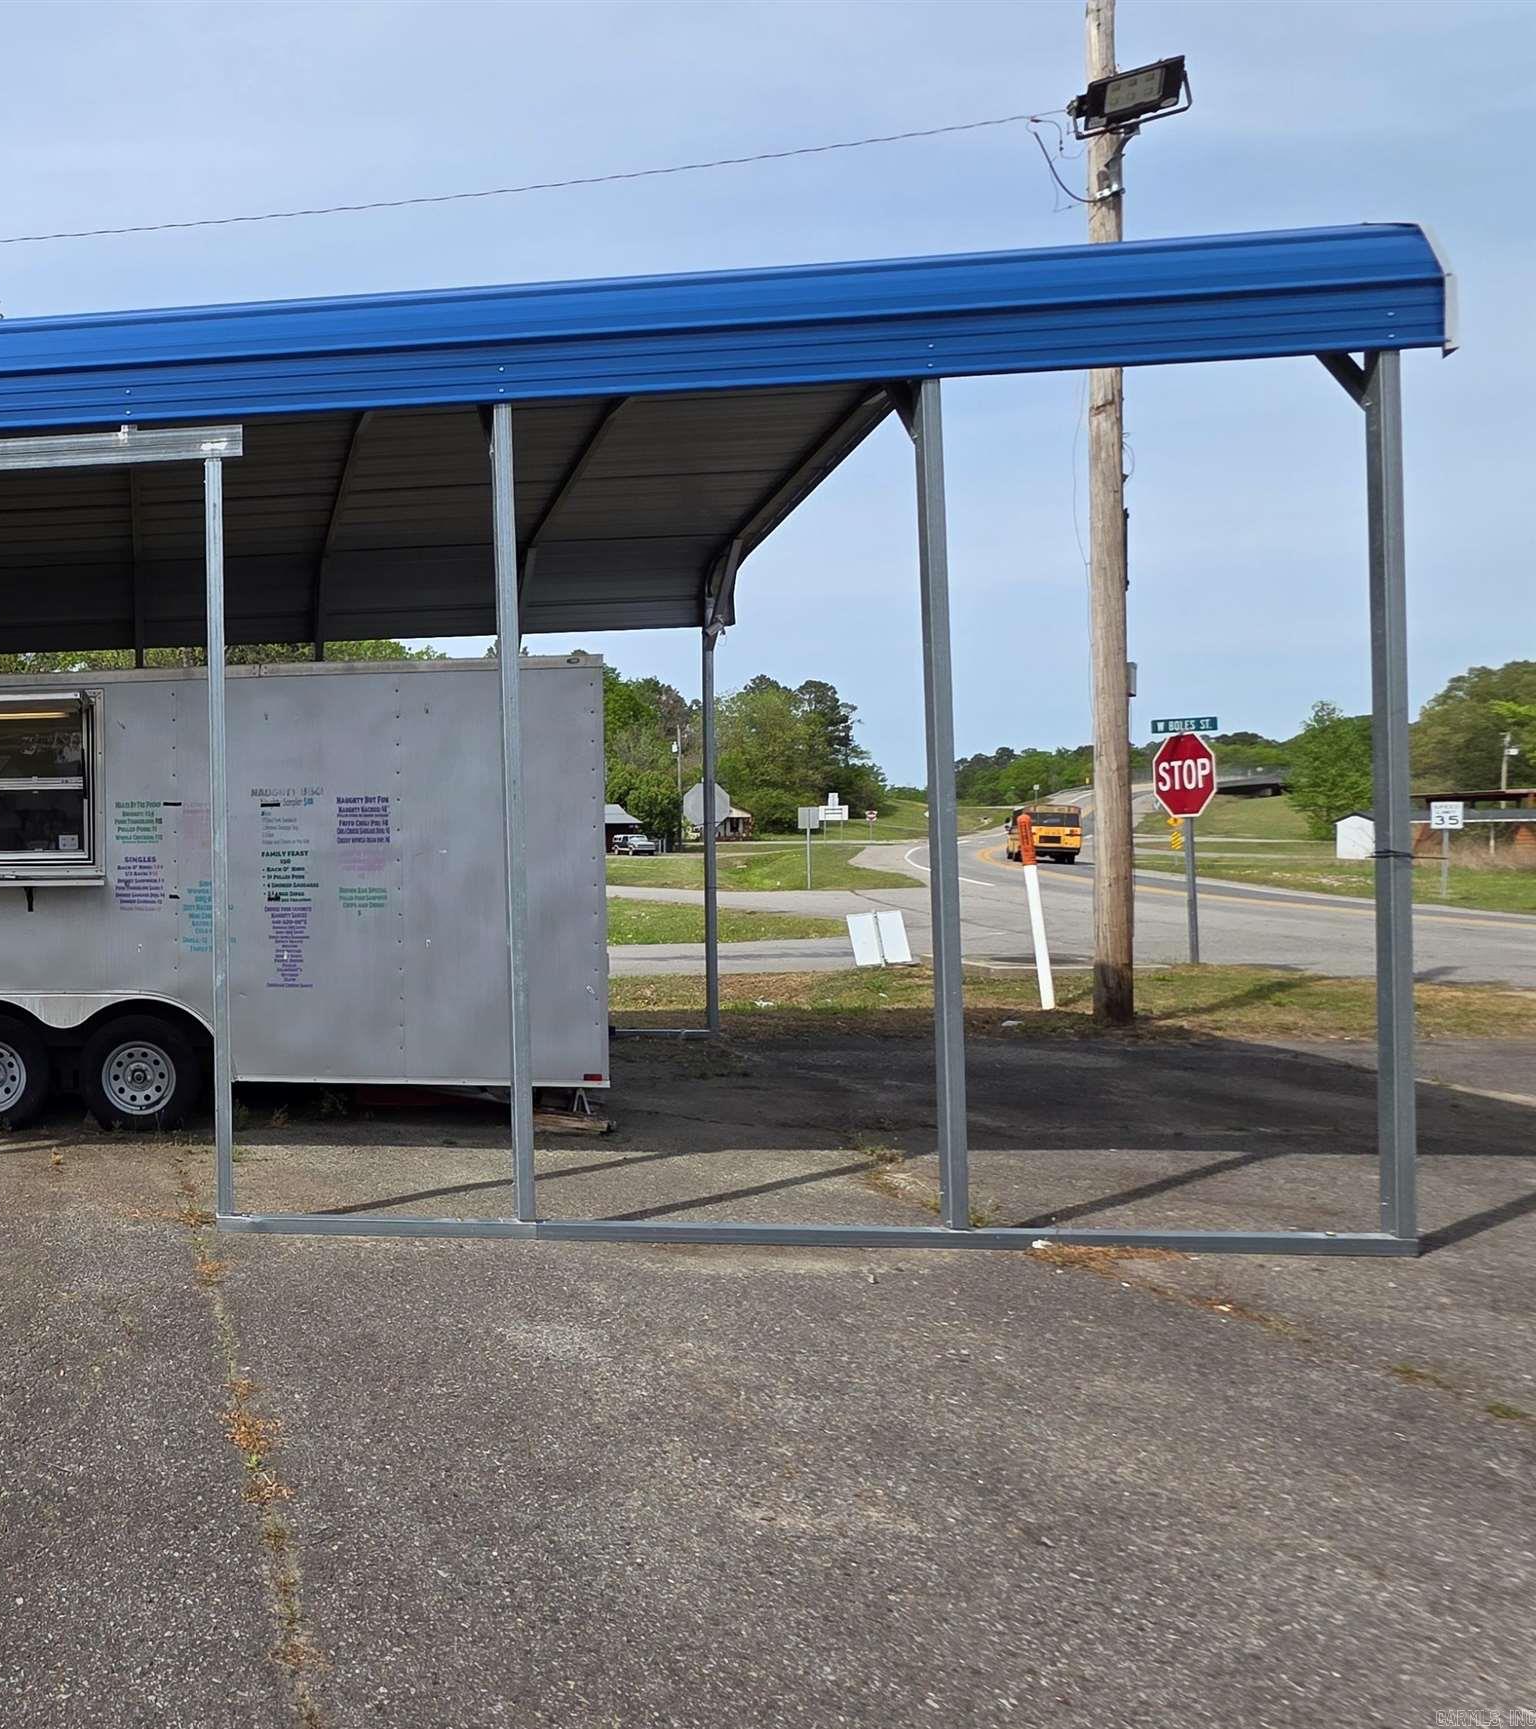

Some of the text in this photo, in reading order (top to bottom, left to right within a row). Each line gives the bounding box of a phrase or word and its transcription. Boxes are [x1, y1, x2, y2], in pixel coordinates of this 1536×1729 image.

[1157, 721, 1165, 732] W
[1158, 758, 1211, 791] STOP
[336, 796, 363, 804] NAUGHTY
[1435, 815, 1459, 826] 35
